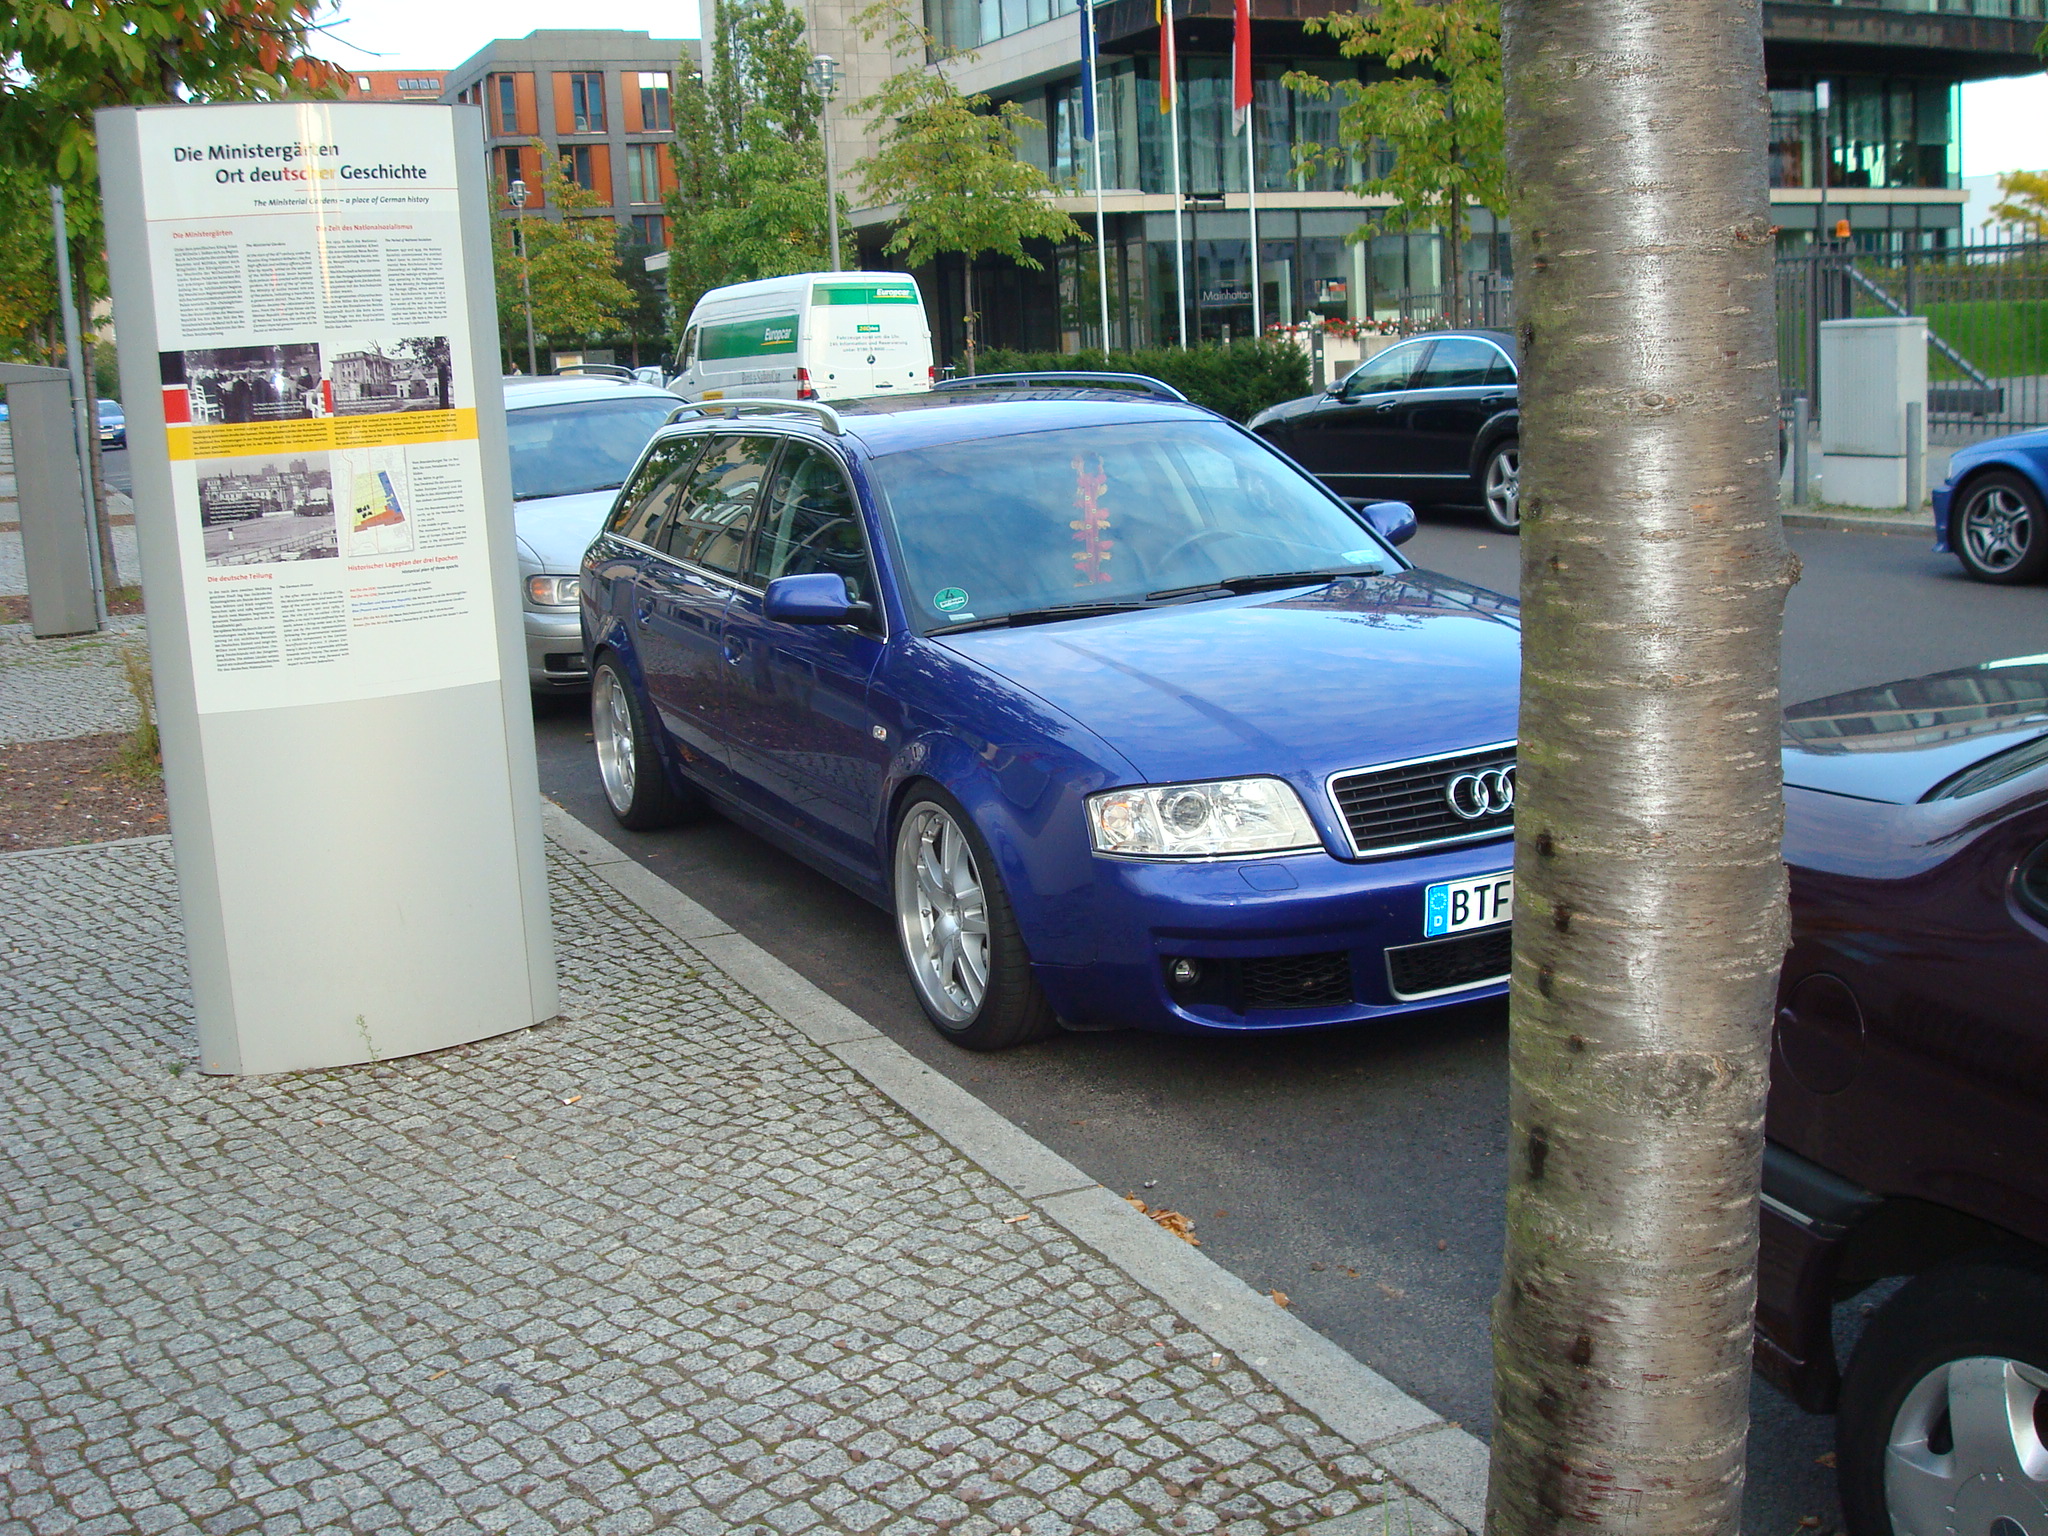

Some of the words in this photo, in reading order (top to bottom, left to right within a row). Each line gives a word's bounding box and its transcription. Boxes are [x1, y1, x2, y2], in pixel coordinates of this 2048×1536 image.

[174, 147, 203, 162] Die
[215, 169, 244, 183] Ort
[250, 165, 335, 182] deutscher
[340, 164, 427, 179] Geschichte
[268, 198, 307, 206] Ministerial
[352, 197, 370, 205] place
[371, 196, 379, 205] of
[407, 195, 430, 204] history
[185, 230, 233, 239] Ministergärten
[876, 288, 910, 296] Europcar
[1203, 289, 1253, 301] Mainhattan
[764, 328, 792, 341] Europcar
[385, 560, 412, 570] Lageplan
[435, 555, 459, 564] Epochen
[219, 573, 248, 582] deutsche
[249, 572, 273, 581] Teilung
[1433, 915, 1443, 927] D
